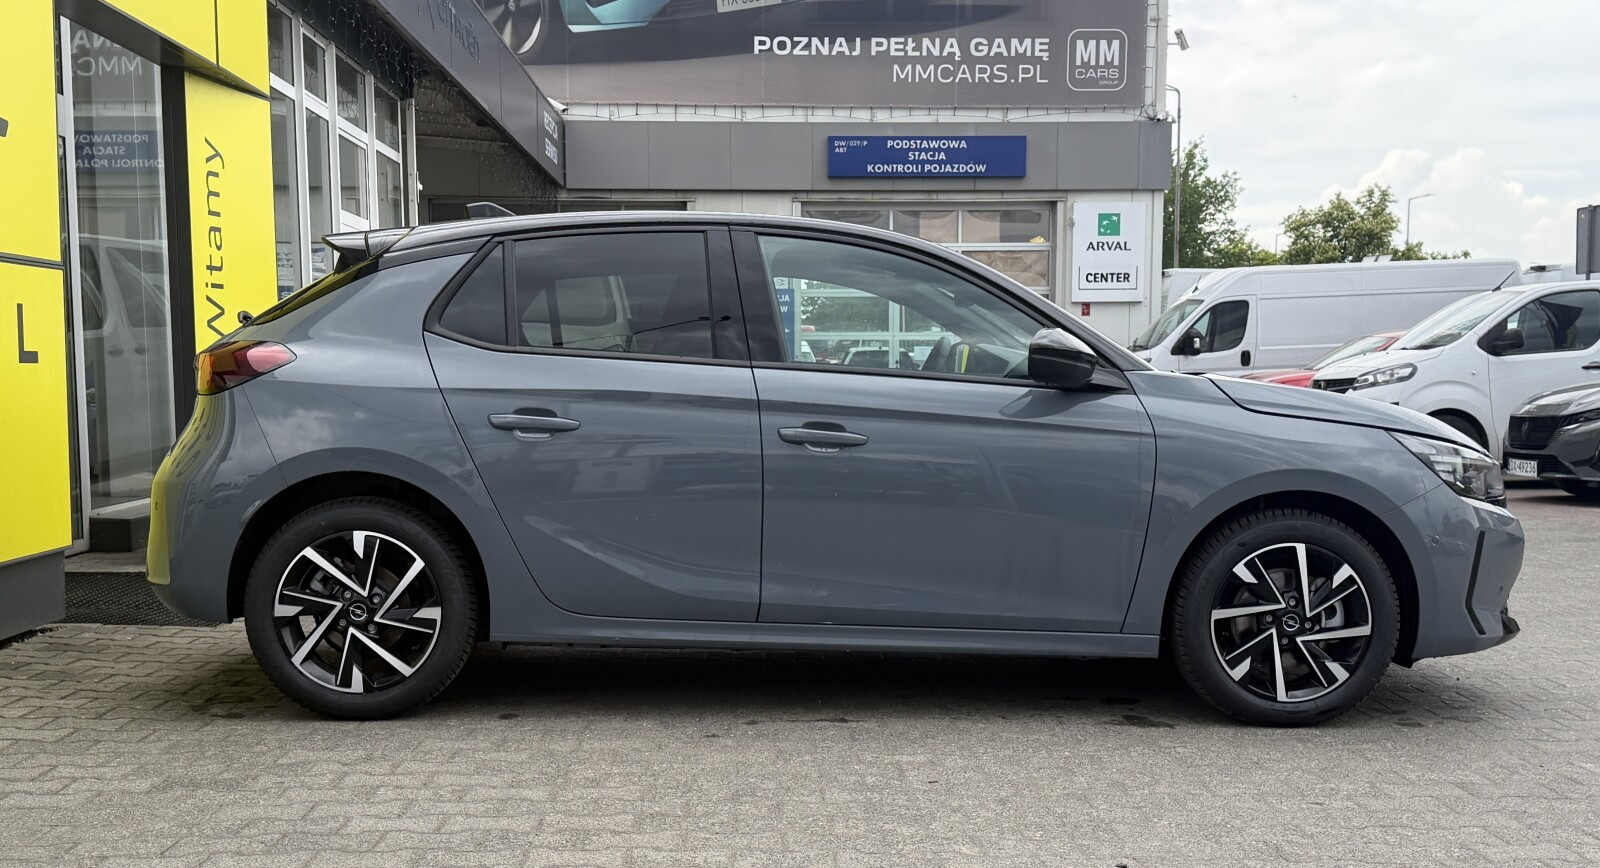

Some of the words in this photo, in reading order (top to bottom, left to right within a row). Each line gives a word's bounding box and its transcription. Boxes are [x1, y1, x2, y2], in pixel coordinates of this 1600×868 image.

[753, 36, 861, 56] POZNAJ
[870, 37, 962, 60] PEŁNĄ
[969, 37, 1050, 61] GAMĘ
[1075, 39, 1120, 66] MM
[892, 63, 1049, 83] MMCARS.PL
[1075, 68, 1119, 79] CARS
[887, 139, 968, 149] PODSTAWOWA
[908, 151, 947, 161] STACJA
[867, 163, 922, 173] KONTROLI
[924, 160, 987, 173] POJAZDÓW
[1086, 241, 1132, 252] ARVAL
[1085, 272, 1131, 283] CENTER
